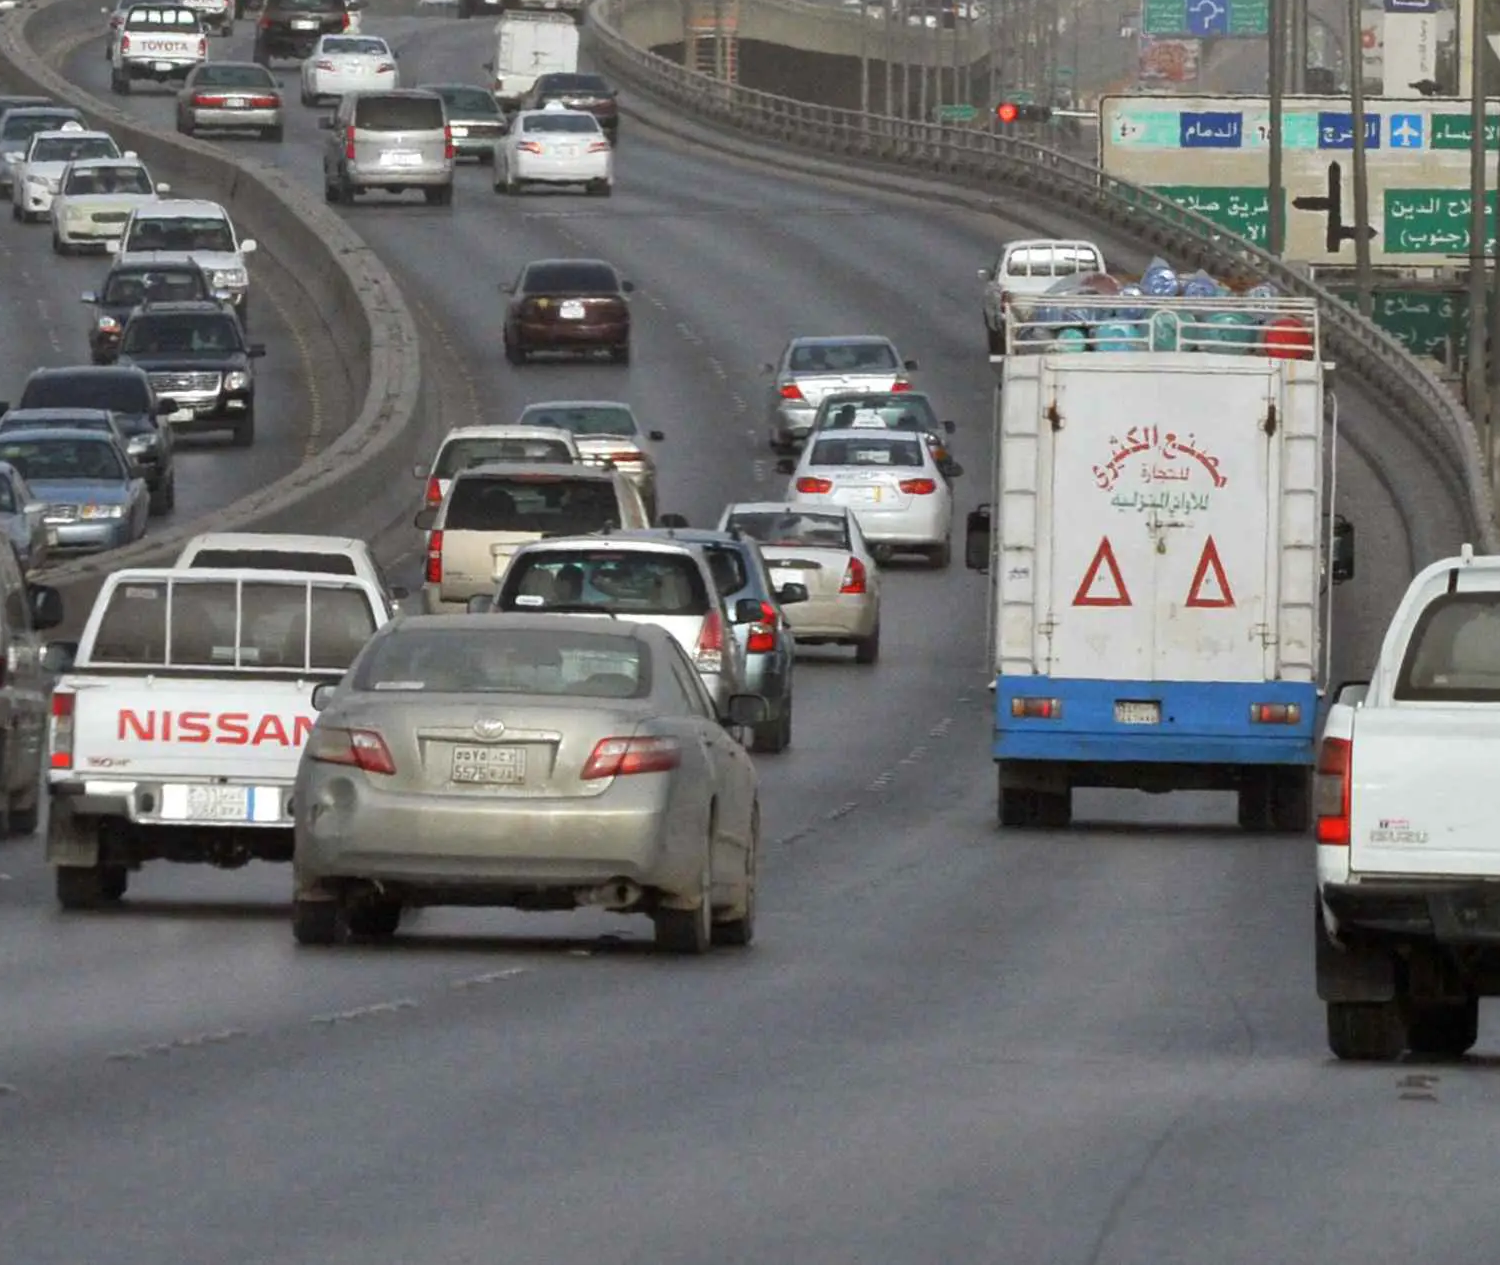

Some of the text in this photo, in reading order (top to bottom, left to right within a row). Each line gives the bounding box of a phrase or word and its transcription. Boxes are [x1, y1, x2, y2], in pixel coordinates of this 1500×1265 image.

[140, 40, 188, 51] TOYOTA
[1185, 121, 1238, 142] الدمام
[1391, 198, 1440, 220] الدين
[1400, 229, 1470, 249] (جنوب)
[1162, 432, 1227, 488] مصنع
